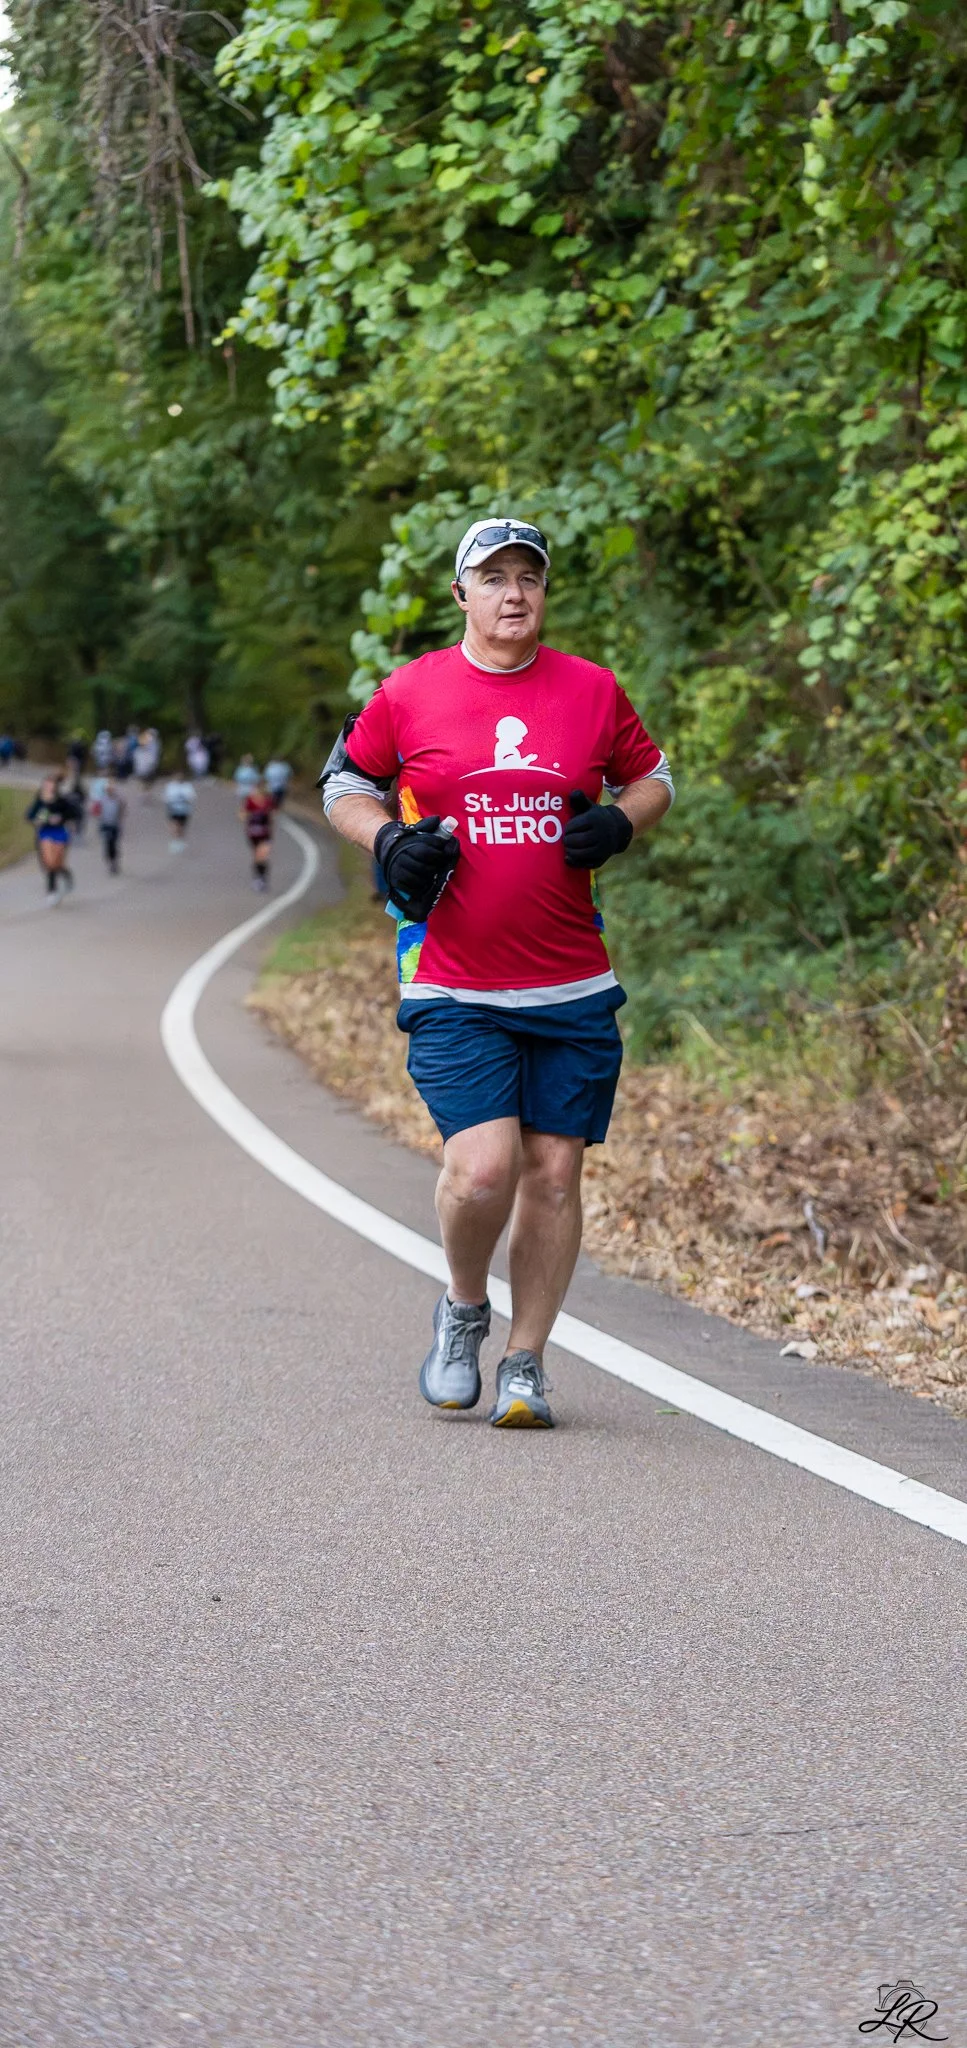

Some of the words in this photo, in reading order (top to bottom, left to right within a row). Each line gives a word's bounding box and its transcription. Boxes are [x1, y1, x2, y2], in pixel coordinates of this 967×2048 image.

[464, 793, 500, 812] St.
[504, 792, 563, 812] Jude
[467, 815, 563, 844] HERO
